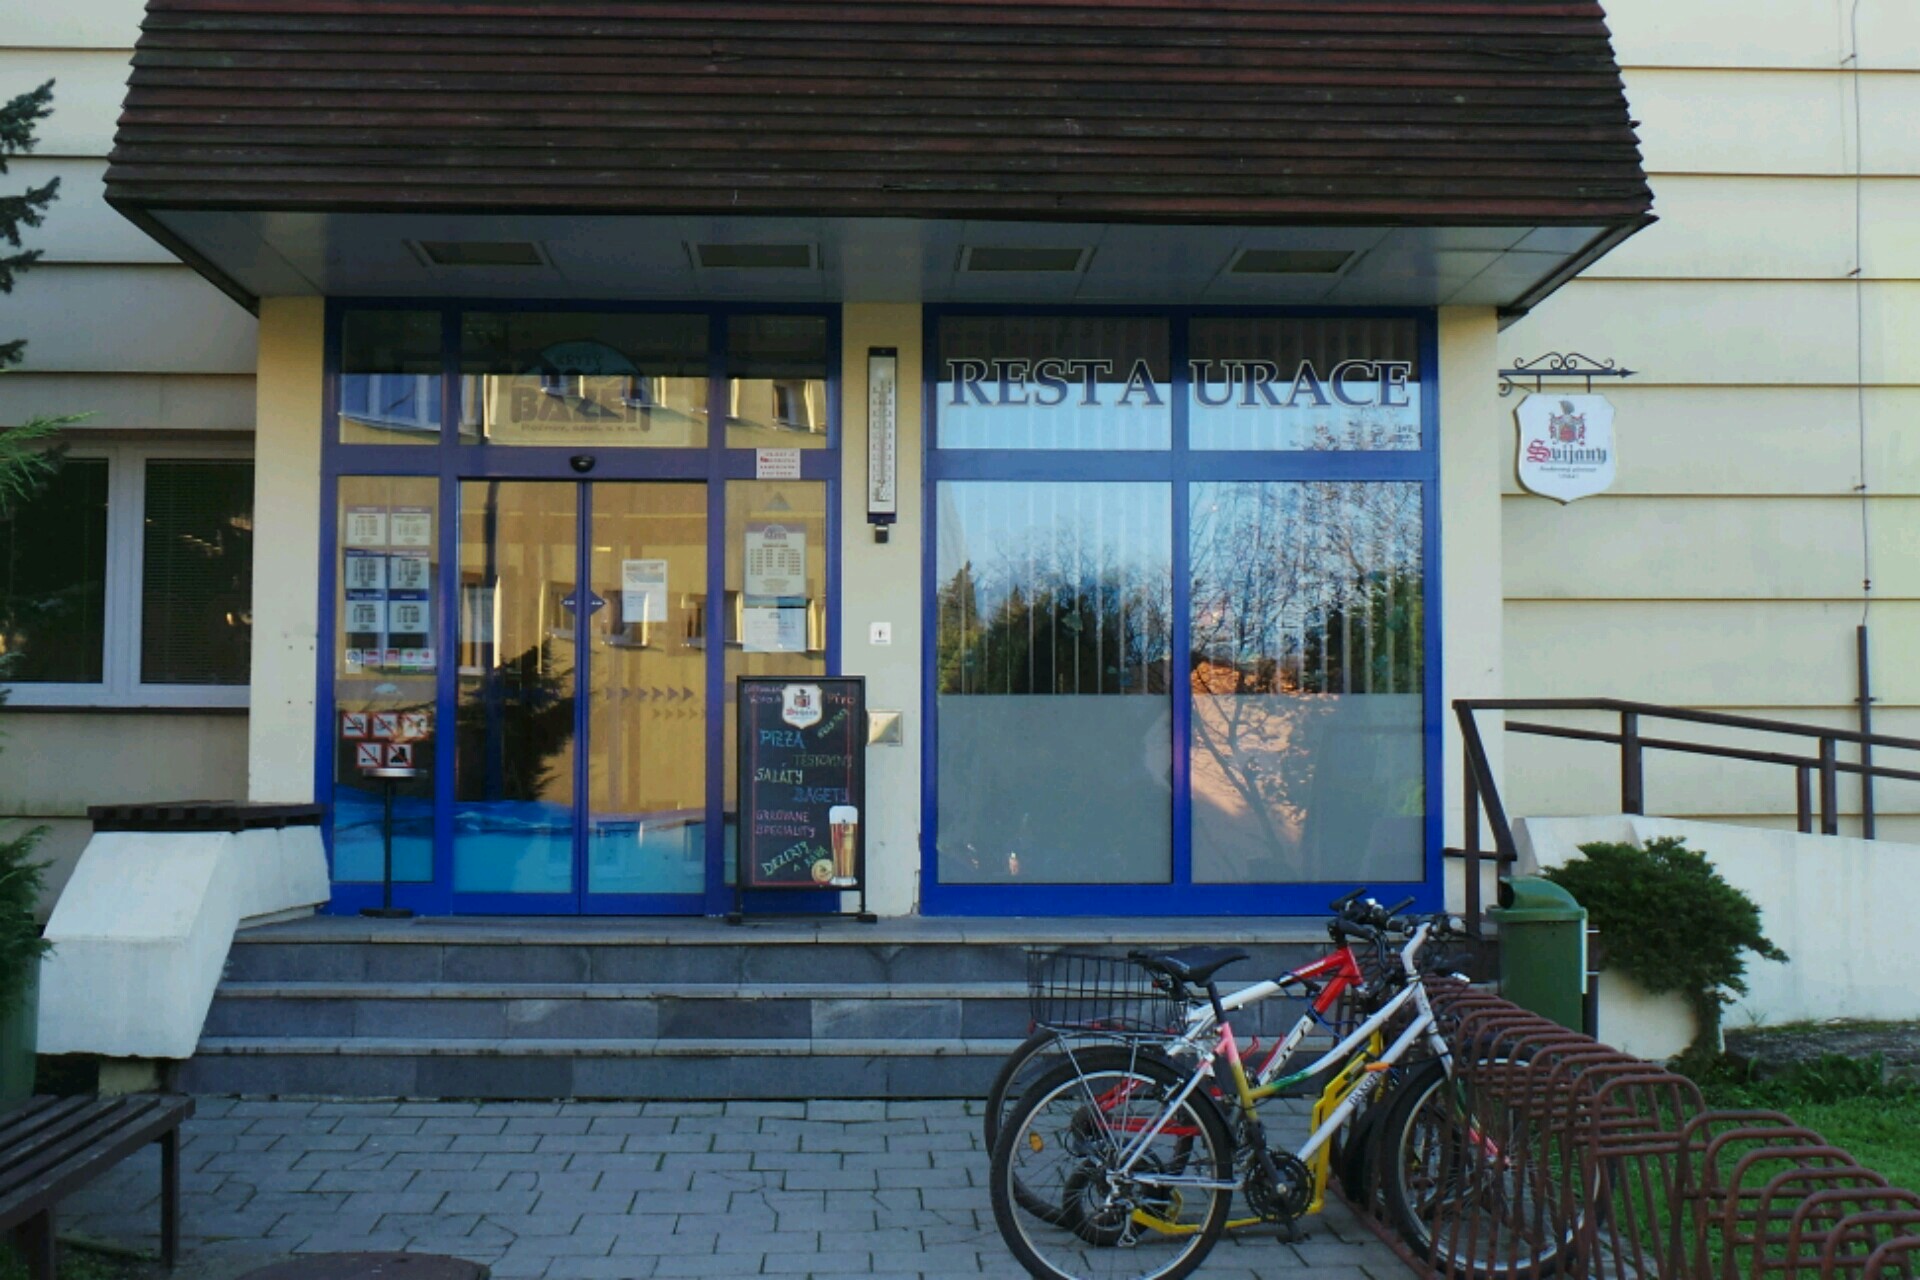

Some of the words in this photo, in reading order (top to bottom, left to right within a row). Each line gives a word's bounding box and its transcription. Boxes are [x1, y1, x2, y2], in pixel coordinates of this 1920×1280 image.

[1526, 438, 1607, 465] Svijany
[760, 728, 805, 749] PIZZA
[1349, 1073, 1378, 1106] DAKOT
